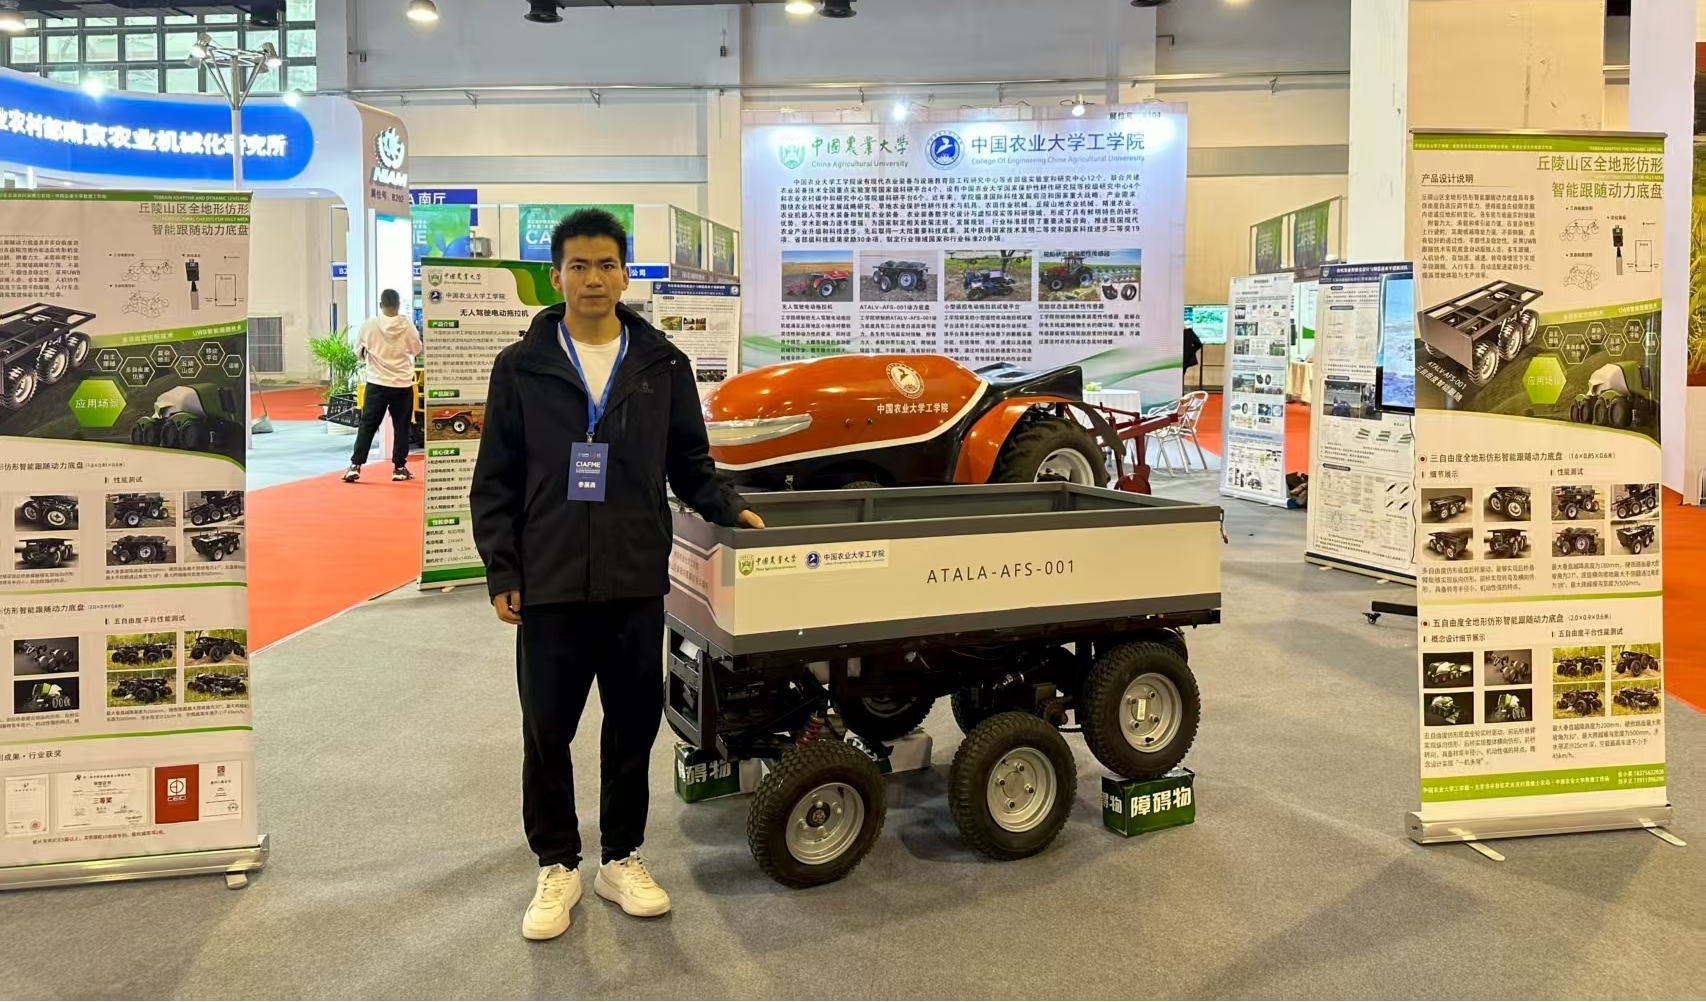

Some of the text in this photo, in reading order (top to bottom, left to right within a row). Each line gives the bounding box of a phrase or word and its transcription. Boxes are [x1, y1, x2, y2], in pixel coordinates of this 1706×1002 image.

[971, 132, 1145, 154] 中国农业大学工学院
[811, 159, 909, 168] China Agricultural University
[971, 157, 997, 165] College
[1007, 156, 1046, 165] Engineering
[1047, 156, 1067, 164] China
[1067, 155, 1107, 164] Agricultural
[1536, 155, 1663, 173] 丘陵山区全地形仿形
[1421, 173, 1474, 185] 产品设计说明
[1551, 181, 1663, 200] 智能跟随动力底盘
[138, 202, 249, 215] 丘陵山区全地形仿形
[152, 224, 249, 236] 智能跟随动力底盘
[445, 292, 506, 300] 中国农业大学工学院
[460, 309, 529, 317] 无人驾驶电动拖拉机
[1426, 361, 1467, 390] ATALV-AFS-001
[75, 398, 120, 410] 应用场景
[876, 402, 949, 415] 中国农业大学工学院
[1430, 451, 1563, 463] 三自由度全地形仿形智能跟随动力底盘
[575, 460, 602, 468] CIAFME
[1429, 469, 1459, 479] 细节展示
[1557, 467, 1584, 477] 性能测试
[824, 549, 885, 561] 中国农业大学工学院
[926, 560, 1076, 585] ATALA-AFS-001
[1432, 613, 1564, 628] 五自由度全地形仿形智能跟随动力底盘
[1431, 633, 1486, 643] 概念设计细节展示
[1557, 627, 1624, 638] 五自由度平台性能测试
[1130, 786, 1192, 818] 障碍物
